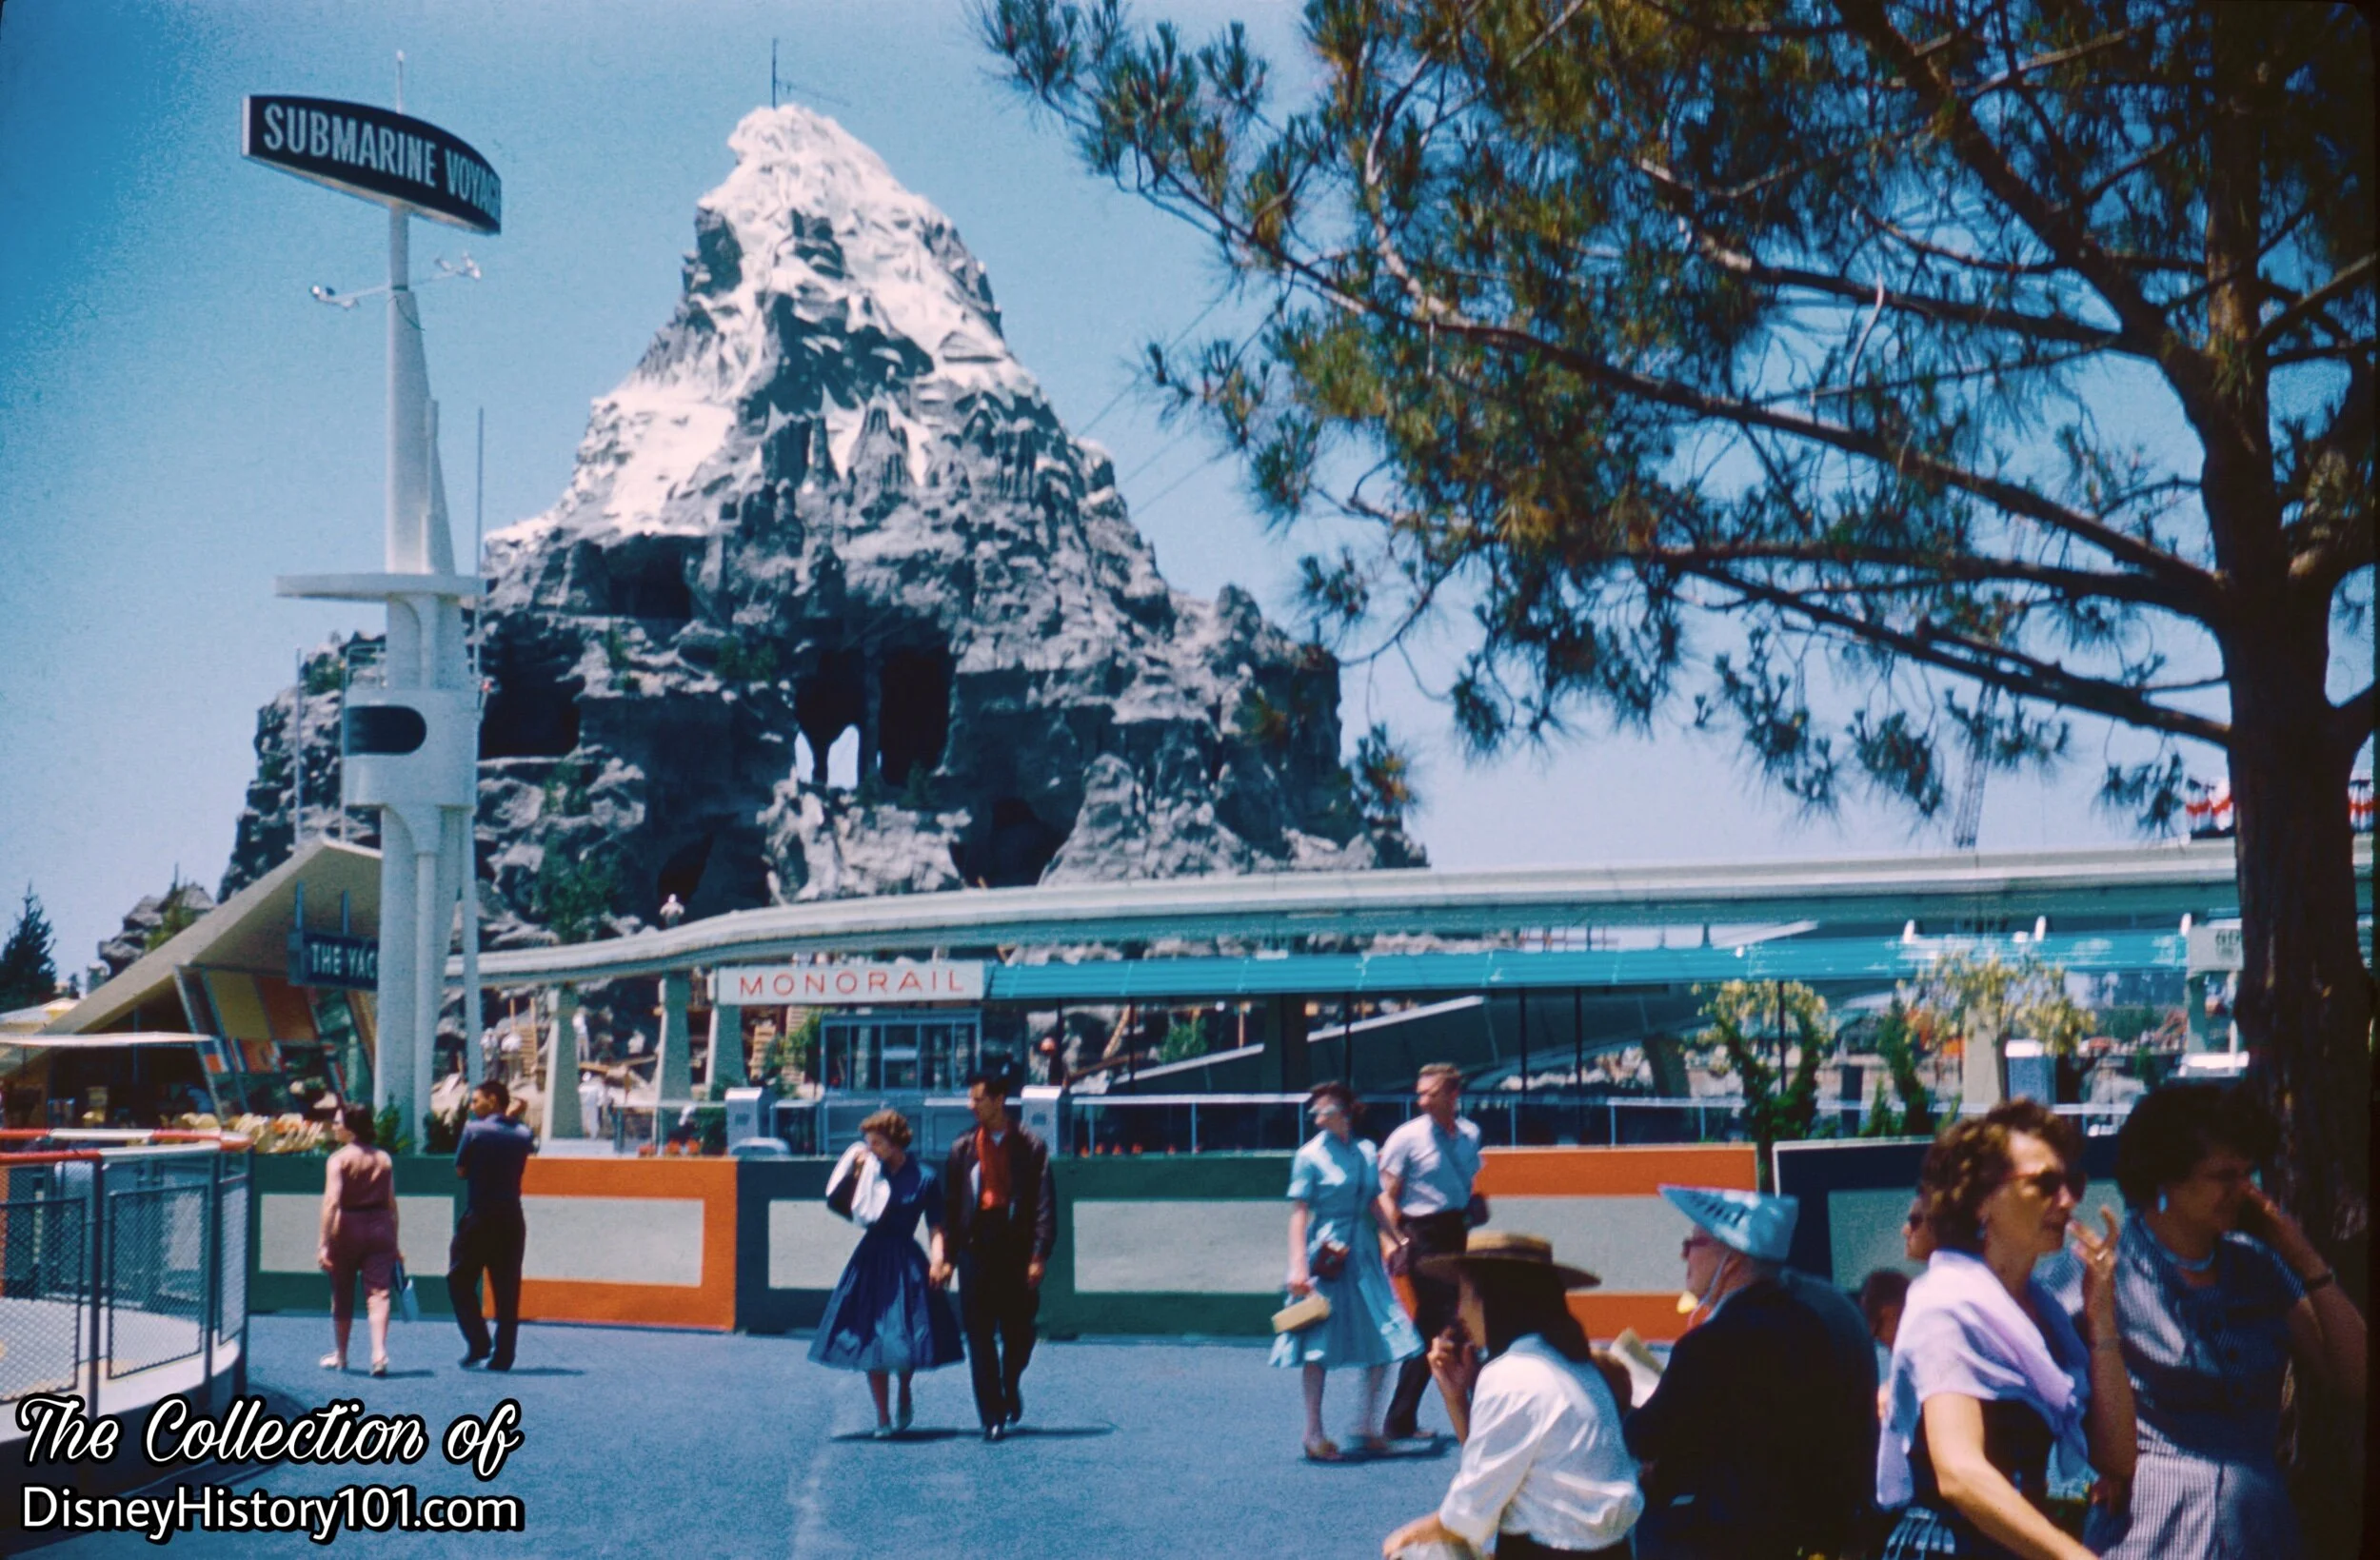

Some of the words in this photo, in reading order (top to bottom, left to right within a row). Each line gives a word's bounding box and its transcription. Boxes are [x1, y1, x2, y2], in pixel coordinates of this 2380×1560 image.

[264, 103, 437, 188] SUBMARINE
[310, 942, 342, 976] THE
[739, 970, 963, 997] MONORAIL
